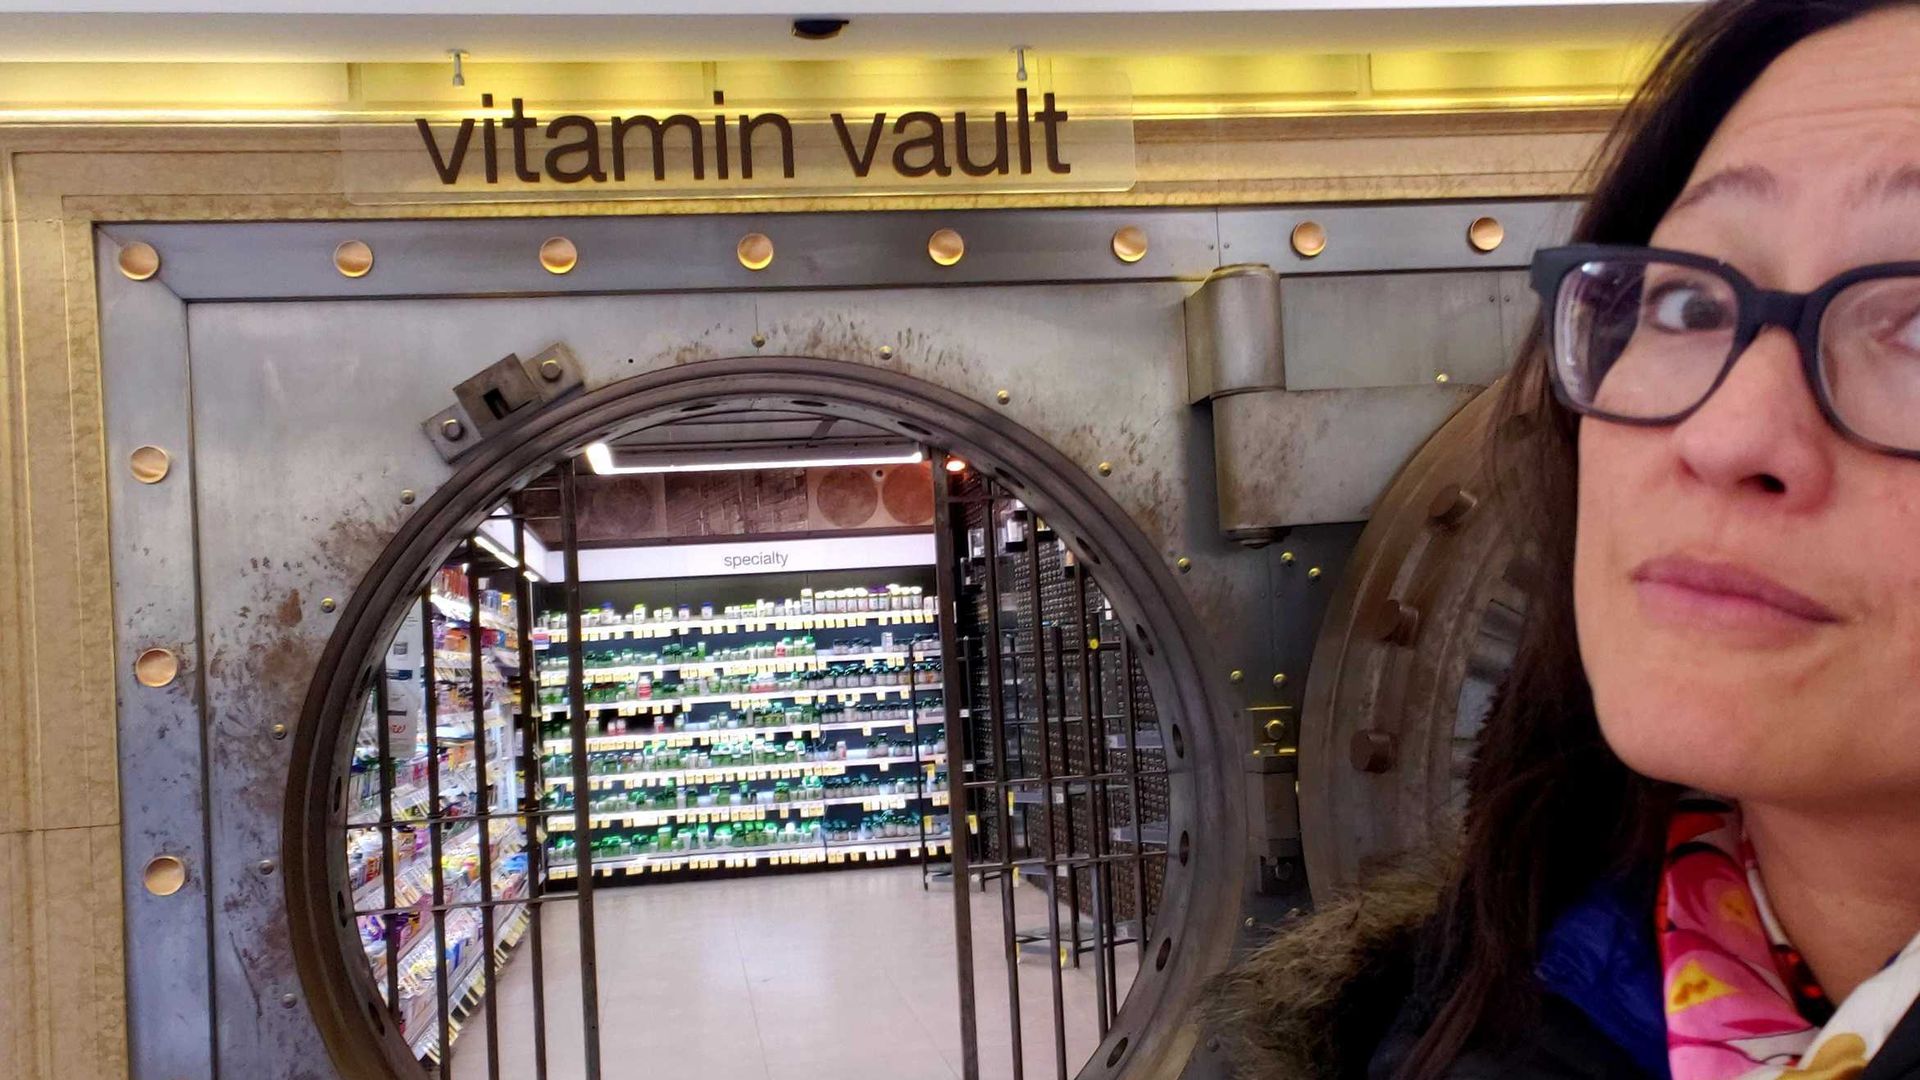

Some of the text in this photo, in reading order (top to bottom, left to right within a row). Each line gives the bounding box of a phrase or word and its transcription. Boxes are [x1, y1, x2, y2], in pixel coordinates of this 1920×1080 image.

[415, 87, 1072, 186] vitamin vault
[724, 551, 788, 568] specialty
